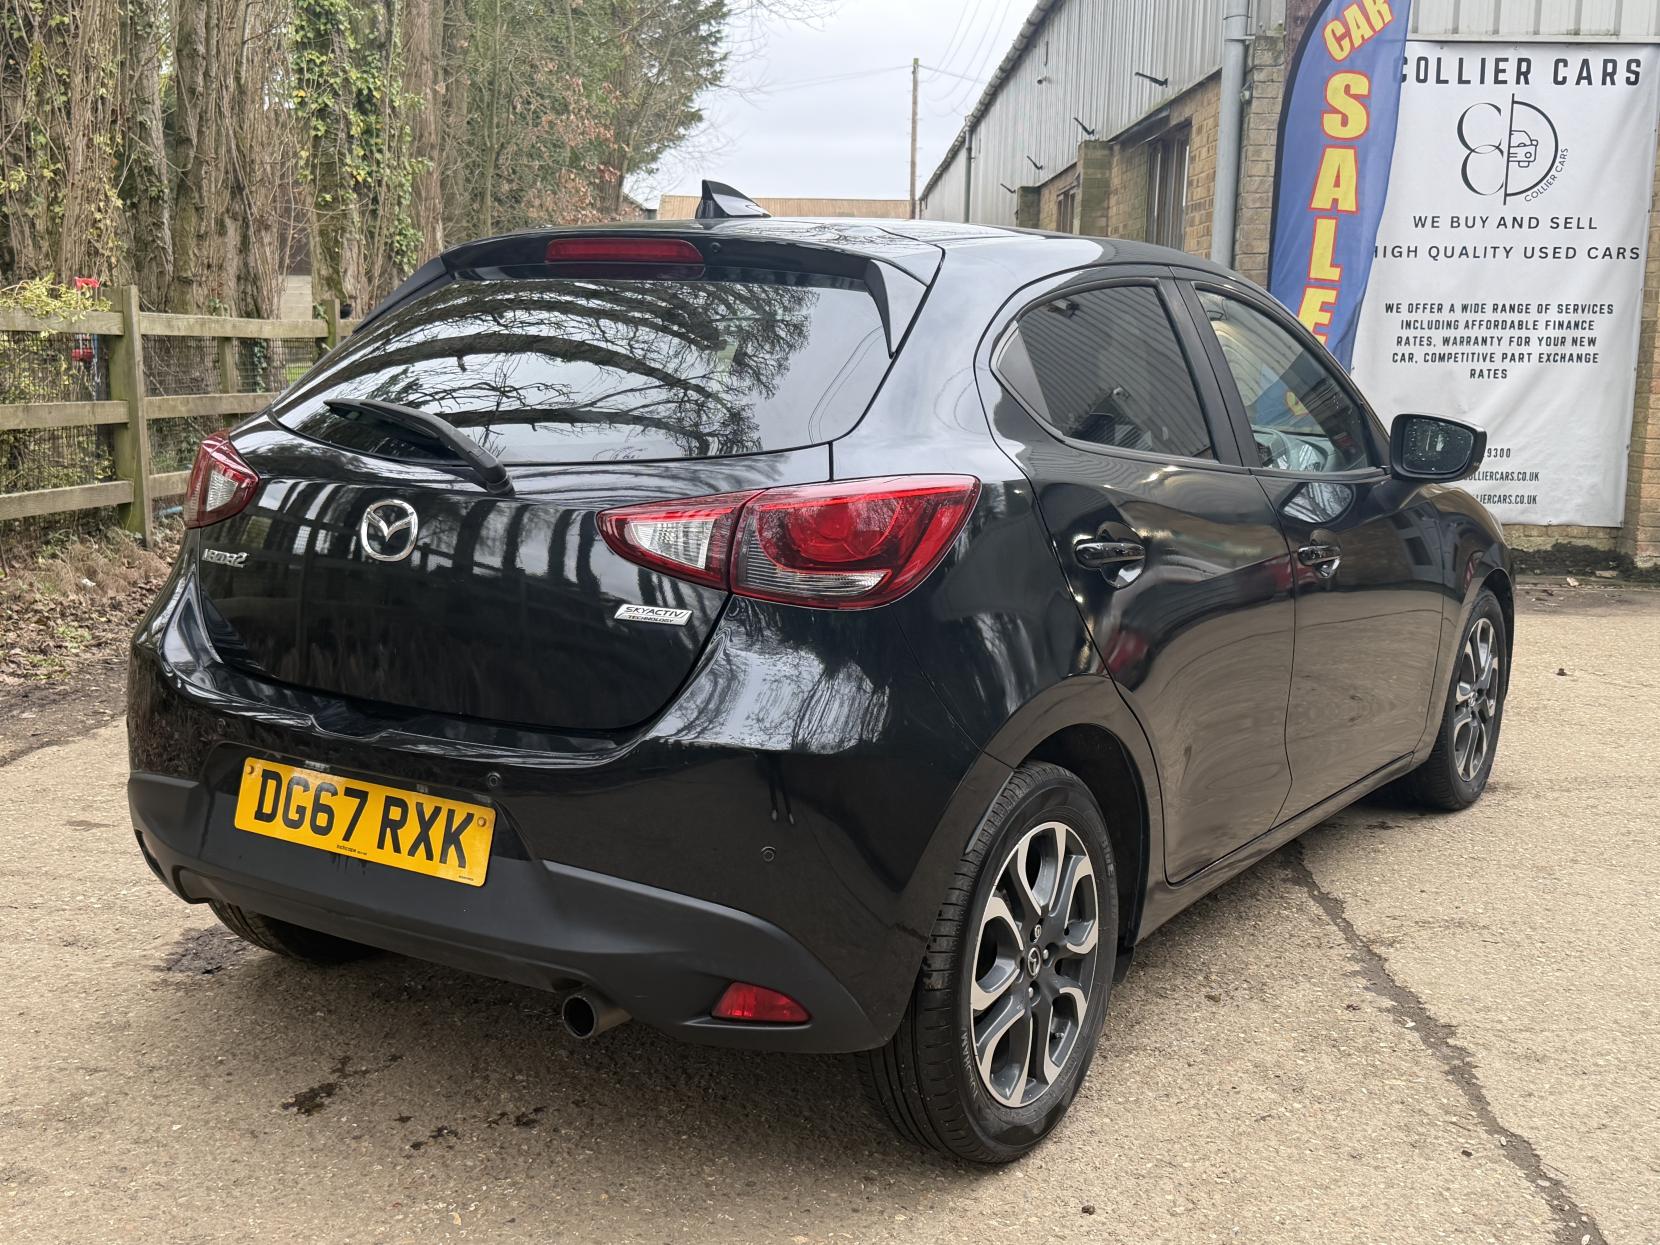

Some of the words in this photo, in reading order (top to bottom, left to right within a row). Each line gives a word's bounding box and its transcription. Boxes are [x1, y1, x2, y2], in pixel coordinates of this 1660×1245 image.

[1324, 0, 1393, 60] CAR
[1552, 57, 1642, 87] CARS
[1524, 174, 1558, 202] COLLIER
[1555, 148, 1569, 173] CARS
[1413, 215, 1441, 229] WE
[1450, 215, 1490, 229] BUY
[1496, 216, 1540, 230] AND
[1549, 216, 1598, 230] SELL
[1428, 246, 1514, 261] QUALITY
[1523, 246, 1577, 260] USED
[1587, 247, 1640, 260] CARS
[1385, 303, 1402, 314] WE
[1408, 303, 1443, 314] OFFER
[1449, 303, 1456, 314] A
[1461, 303, 1487, 314] WIDE
[1492, 303, 1531, 314] RANGE
[1537, 303, 1551, 314] OF
[1557, 303, 1614, 314] SERVICES
[1401, 320, 1460, 331] INCLUDING
[1464, 320, 1539, 331] AFFORDABLE
[1545, 320, 1595, 331] FINANCE
[1396, 336, 1436, 347] RATES,
[1442, 336, 1503, 347] WARRANTY
[1509, 336, 1531, 347] FOR
[1538, 336, 1567, 347] YOUR
[1571, 336, 1597, 347] NEW
[1392, 352, 1418, 364] CAR,
[1423, 352, 1496, 364] COMPETITIVE
[1501, 352, 1533, 364] PART
[1538, 352, 1599, 364] EXCHANGE
[1469, 369, 1508, 379] RATES
[1484, 448, 1511, 459] 9300
[1474, 494, 1538, 505] IERCARS.CO.UK
[625, 606, 683, 617] SKYACTIV
[628, 615, 674, 623] TECHNOLOGY
[254, 768, 369, 842] DG67
[377, 795, 475, 870] RXK
